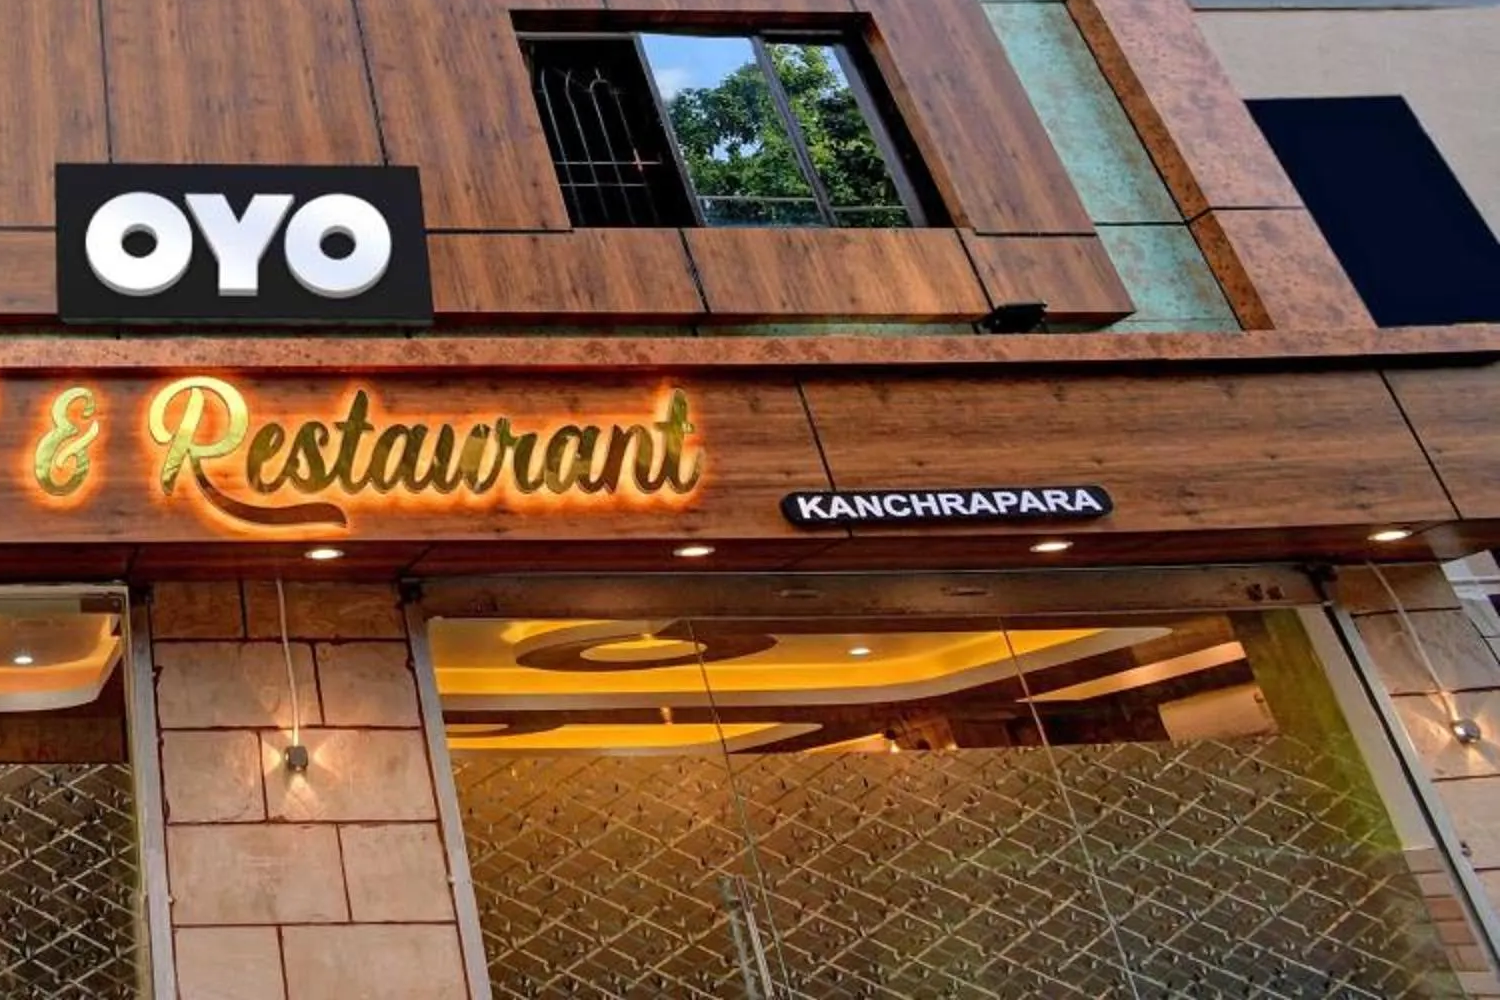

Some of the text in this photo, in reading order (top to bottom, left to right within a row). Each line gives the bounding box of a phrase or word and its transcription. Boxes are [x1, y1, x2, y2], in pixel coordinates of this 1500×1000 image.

[85, 191, 392, 298] OYO
[35, 387, 99, 496] &
[148, 375, 701, 528] Restaurant
[798, 488, 1102, 520] KANCHRAPARA
